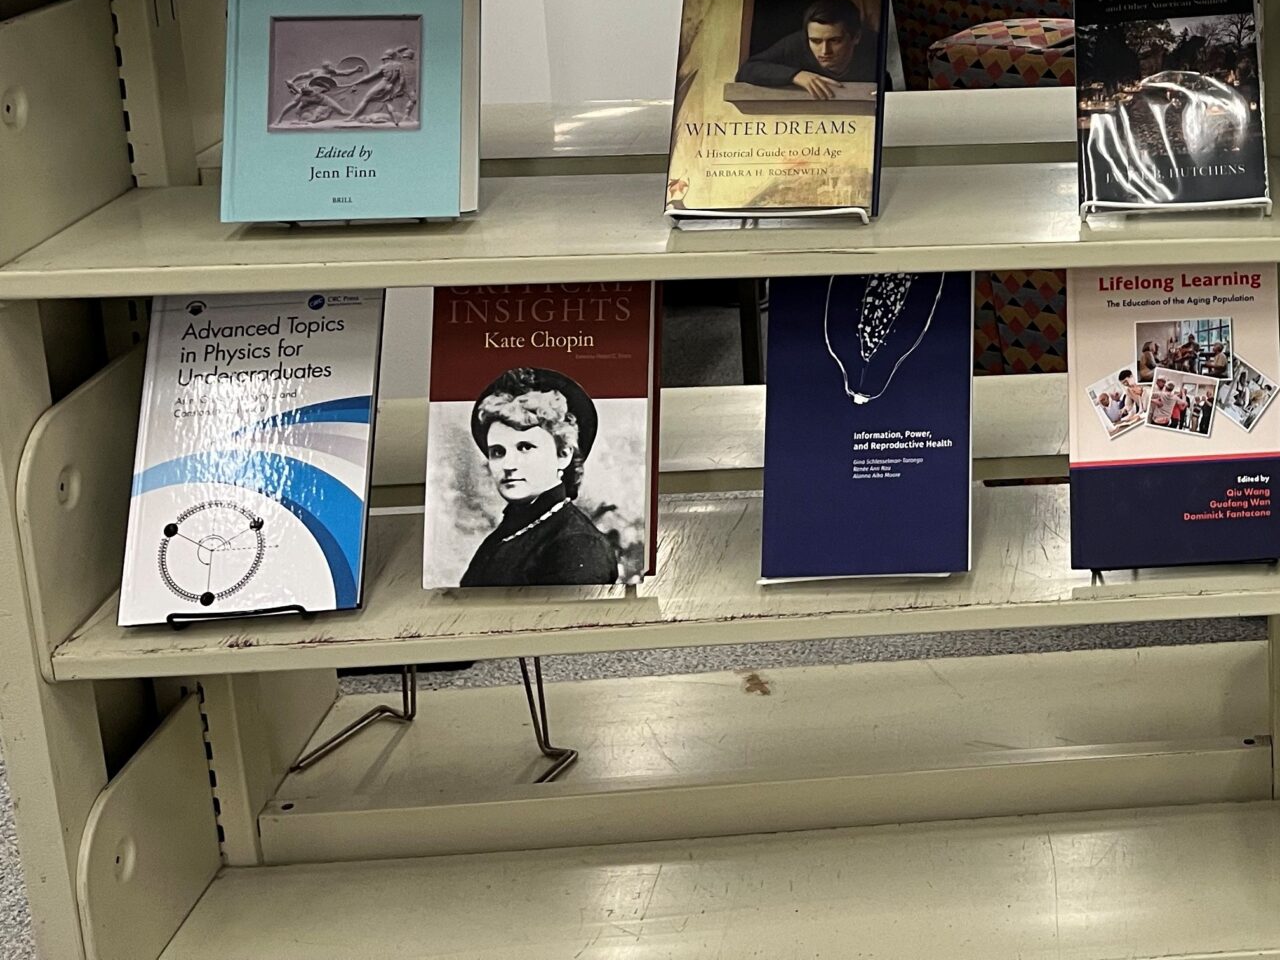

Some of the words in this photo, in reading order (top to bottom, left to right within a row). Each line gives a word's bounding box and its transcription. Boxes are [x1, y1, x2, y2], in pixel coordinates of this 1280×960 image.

[686, 120, 768, 136] WINTER
[775, 120, 857, 136] DREAMS
[315, 146, 356, 159] Edited
[359, 147, 373, 162] by
[706, 147, 753, 159] Historical
[756, 147, 786, 158] Guide
[788, 149, 799, 158] to
[802, 147, 820, 158] Old
[823, 147, 842, 160] Age
[309, 166, 341, 182] Jenn
[345, 166, 377, 179] Finn
[1099, 275, 1174, 292] Lifelong
[1181, 272, 1262, 290] Learning
[1107, 299, 1120, 308] The
[1122, 298, 1160, 308] Education
[1187, 296, 1211, 307] Aging
[1212, 294, 1255, 306] Population
[448, 297, 631, 324] INSIGHTS
[181, 317, 280, 341] Advanced
[287, 316, 345, 338] Topics
[484, 332, 525, 348] Kate
[531, 330, 594, 352] Chopin
[180, 346, 197, 364] in
[204, 342, 271, 366] Physics
[277, 339, 303, 358] for
[853, 431, 904, 442] Information,
[905, 430, 932, 440] Power,
[853, 442, 869, 451] and
[871, 440, 924, 451] Reproductive
[926, 439, 953, 449] Health
